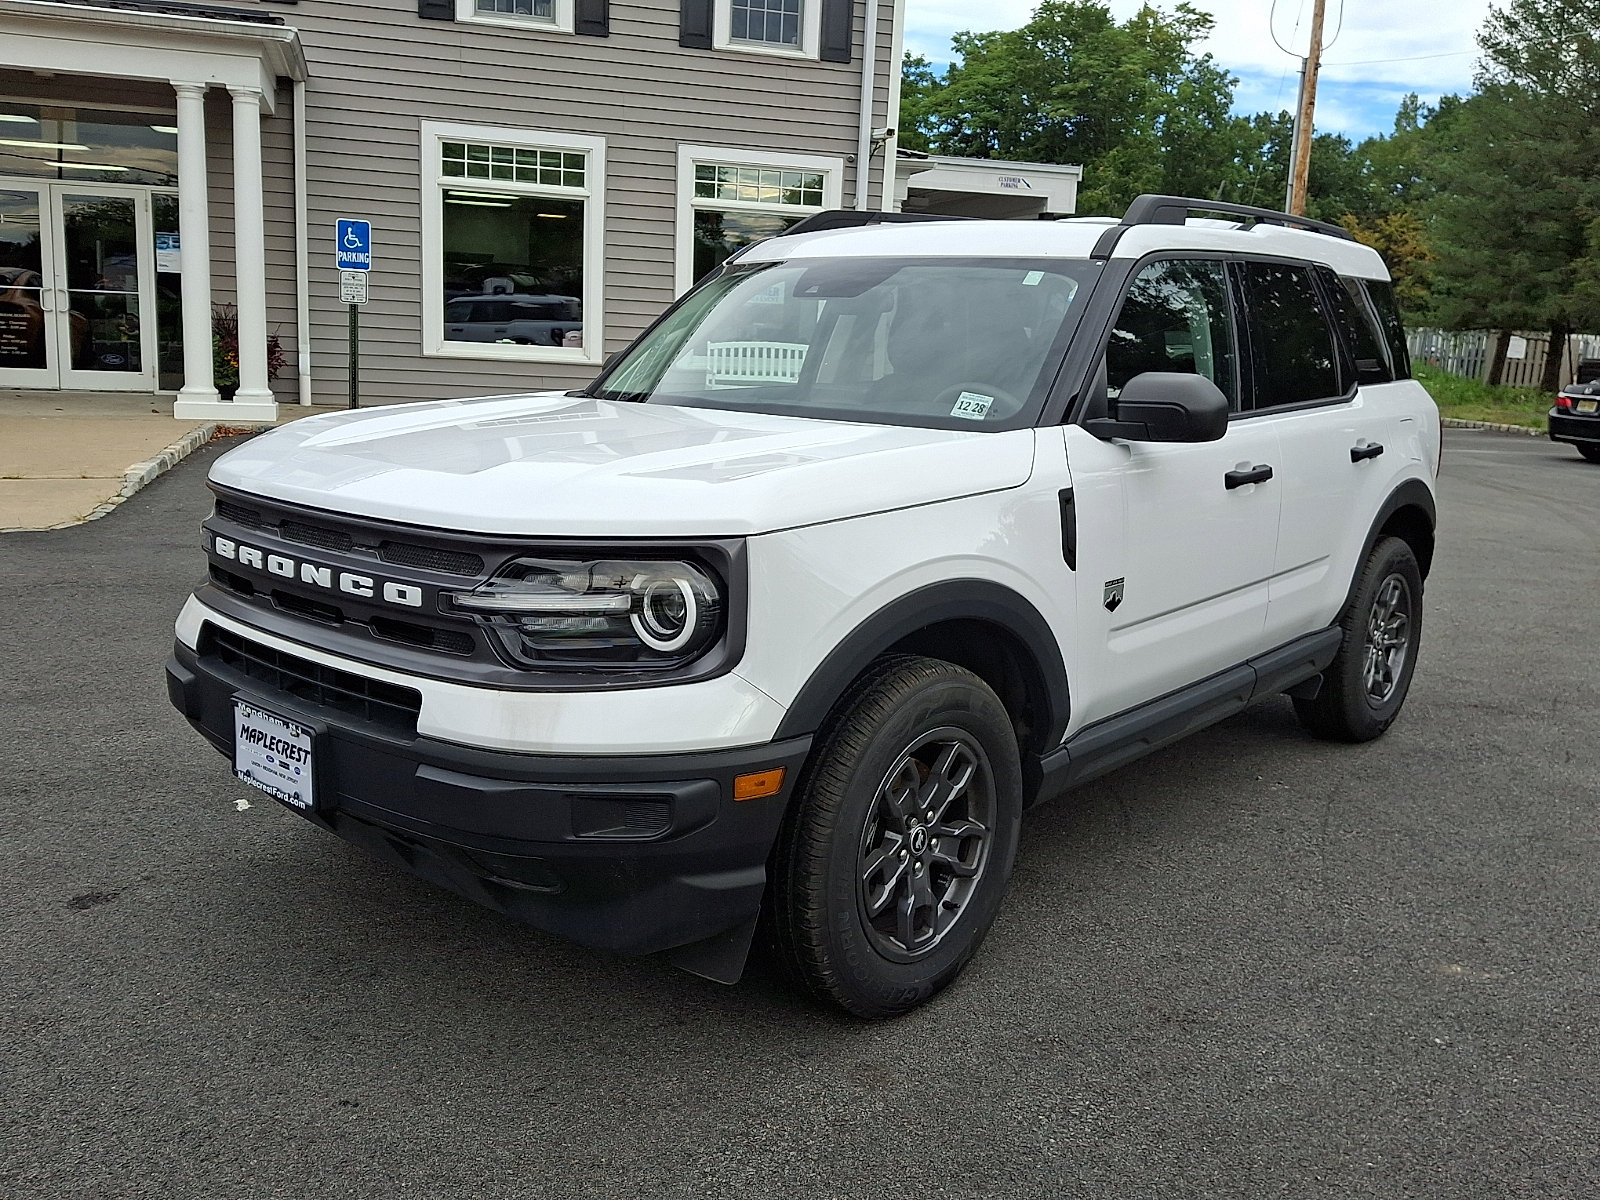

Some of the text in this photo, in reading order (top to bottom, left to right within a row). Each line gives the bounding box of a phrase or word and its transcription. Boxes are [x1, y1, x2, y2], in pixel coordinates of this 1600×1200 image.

[338, 250, 369, 264] PARKING
[957, 400, 986, 413] 12 28
[215, 536, 422, 608] BRONCO
[238, 702, 302, 734] Mendham, NJ
[240, 723, 311, 766] MAPLECREST
[237, 770, 306, 810] MaplecrestFord.com
